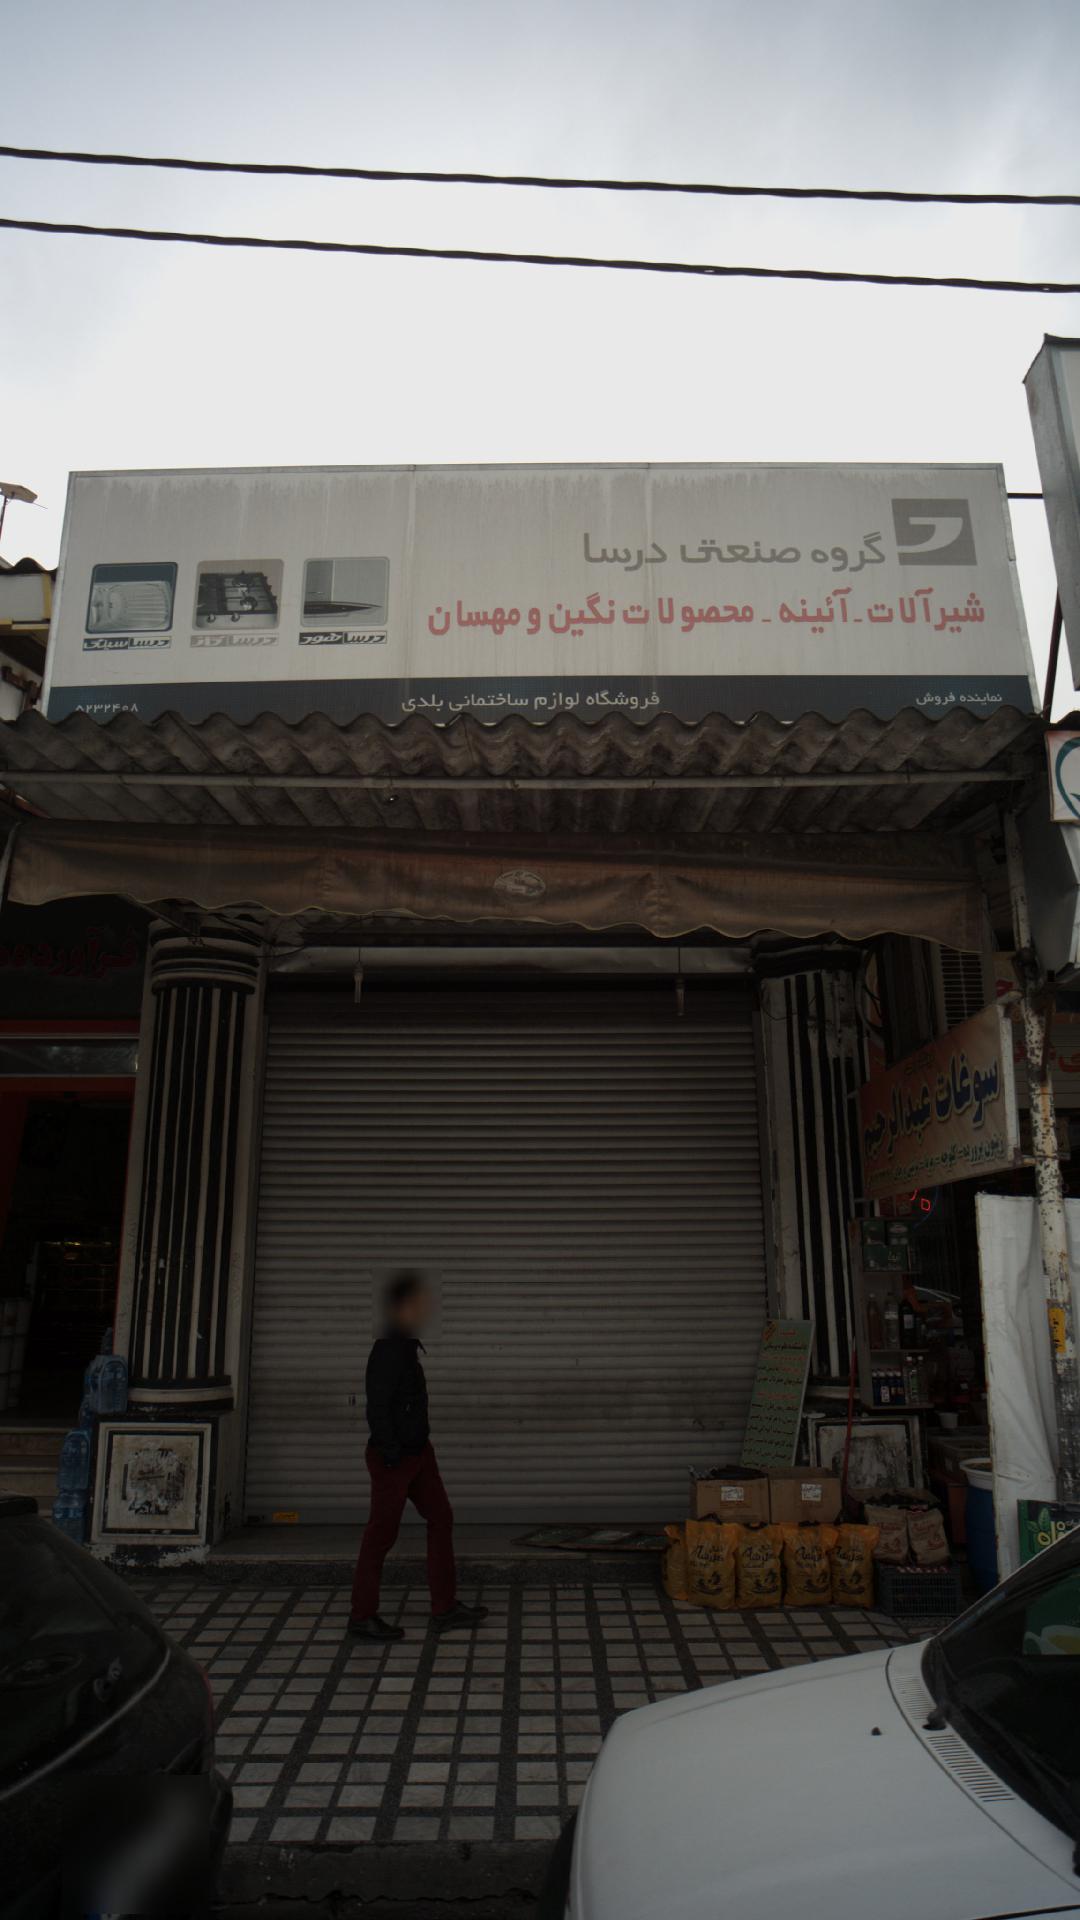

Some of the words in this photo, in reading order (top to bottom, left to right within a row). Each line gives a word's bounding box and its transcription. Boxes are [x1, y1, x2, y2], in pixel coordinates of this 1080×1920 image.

[582, 532, 668, 572] درسا
[679, 539, 801, 564] صنعتی
[810, 531, 887, 572] گروه
[428, 600, 521, 636] مهسان
[526, 606, 541, 635] و
[548, 592, 616, 636] نگین
[622, 597, 755, 632] محصولات
[401, 694, 444, 712] بلدی
[448, 693, 529, 711] ساختمانی
[533, 692, 579, 710] لوازم
[585, 690, 660, 710] فروشگاه
[915, 691, 956, 706] فروش
[960, 692, 1003, 706] نماینده
[935, 1048, 1000, 1127] سوغات
